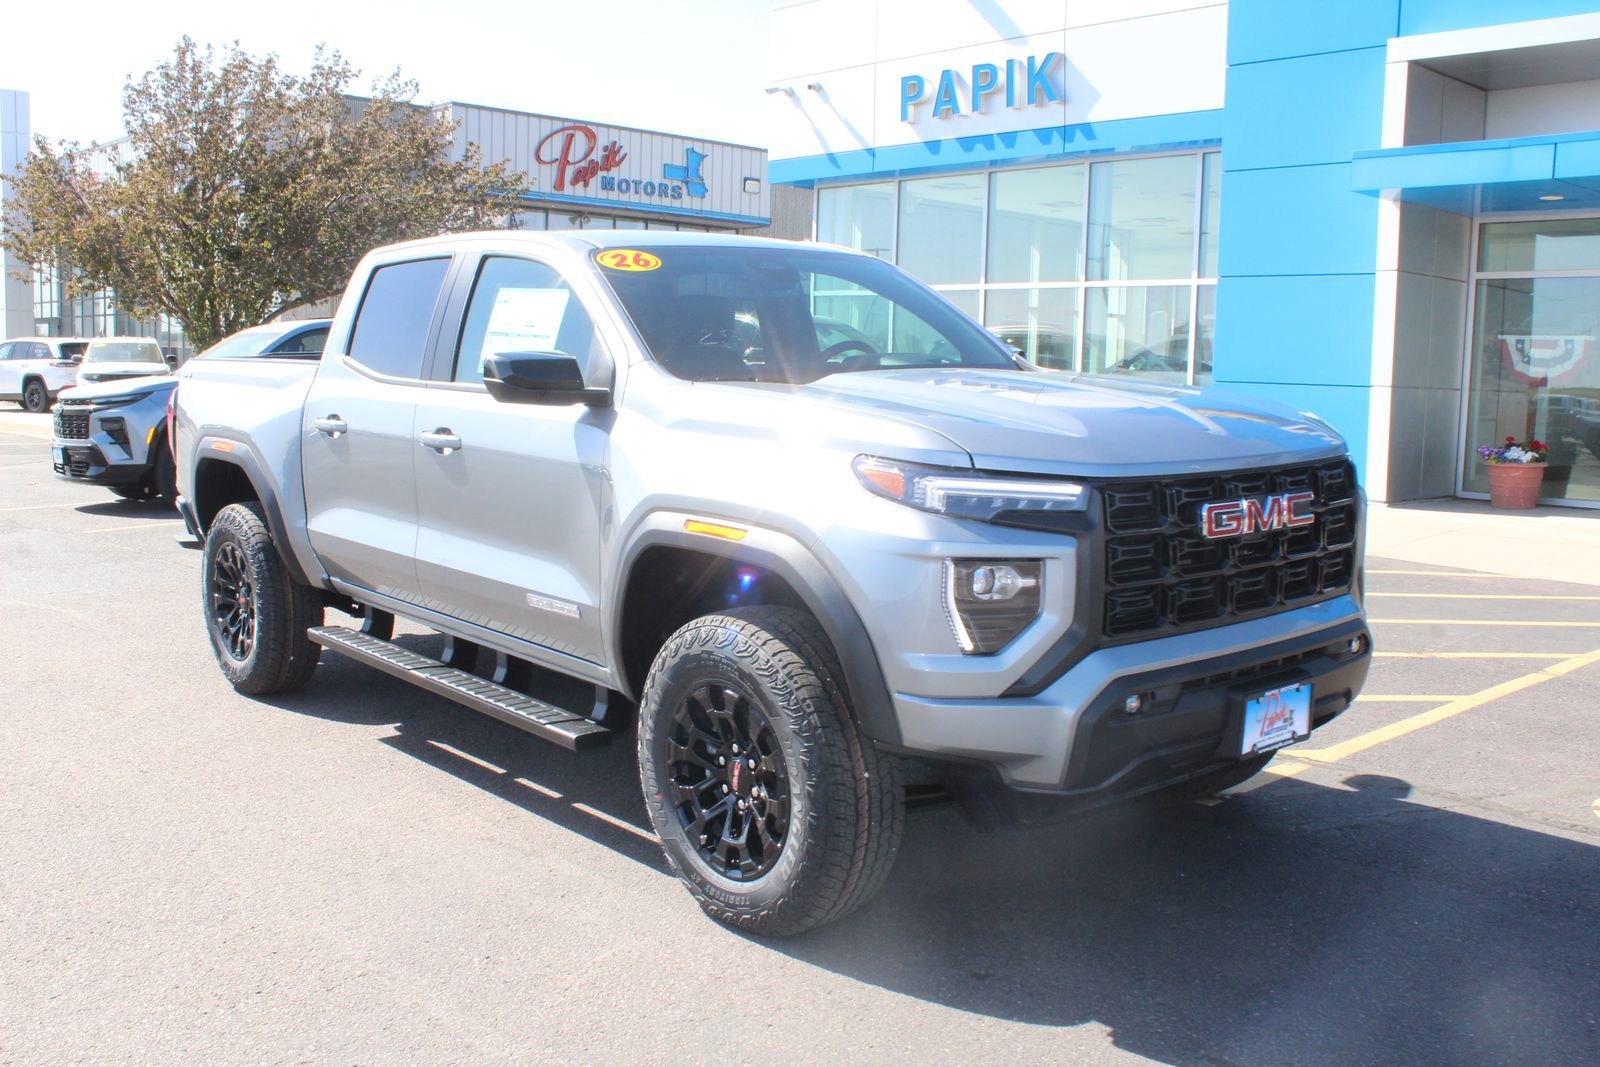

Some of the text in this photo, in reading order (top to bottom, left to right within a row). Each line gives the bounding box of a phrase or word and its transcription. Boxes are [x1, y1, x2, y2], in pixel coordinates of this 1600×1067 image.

[900, 52, 1060, 123] PAPIK
[535, 125, 628, 192] Papik
[601, 175, 683, 200] MOTORS
[610, 253, 651, 268] 26
[1202, 491, 1315, 539] GMC
[703, 884, 751, 905] TERRITORY
